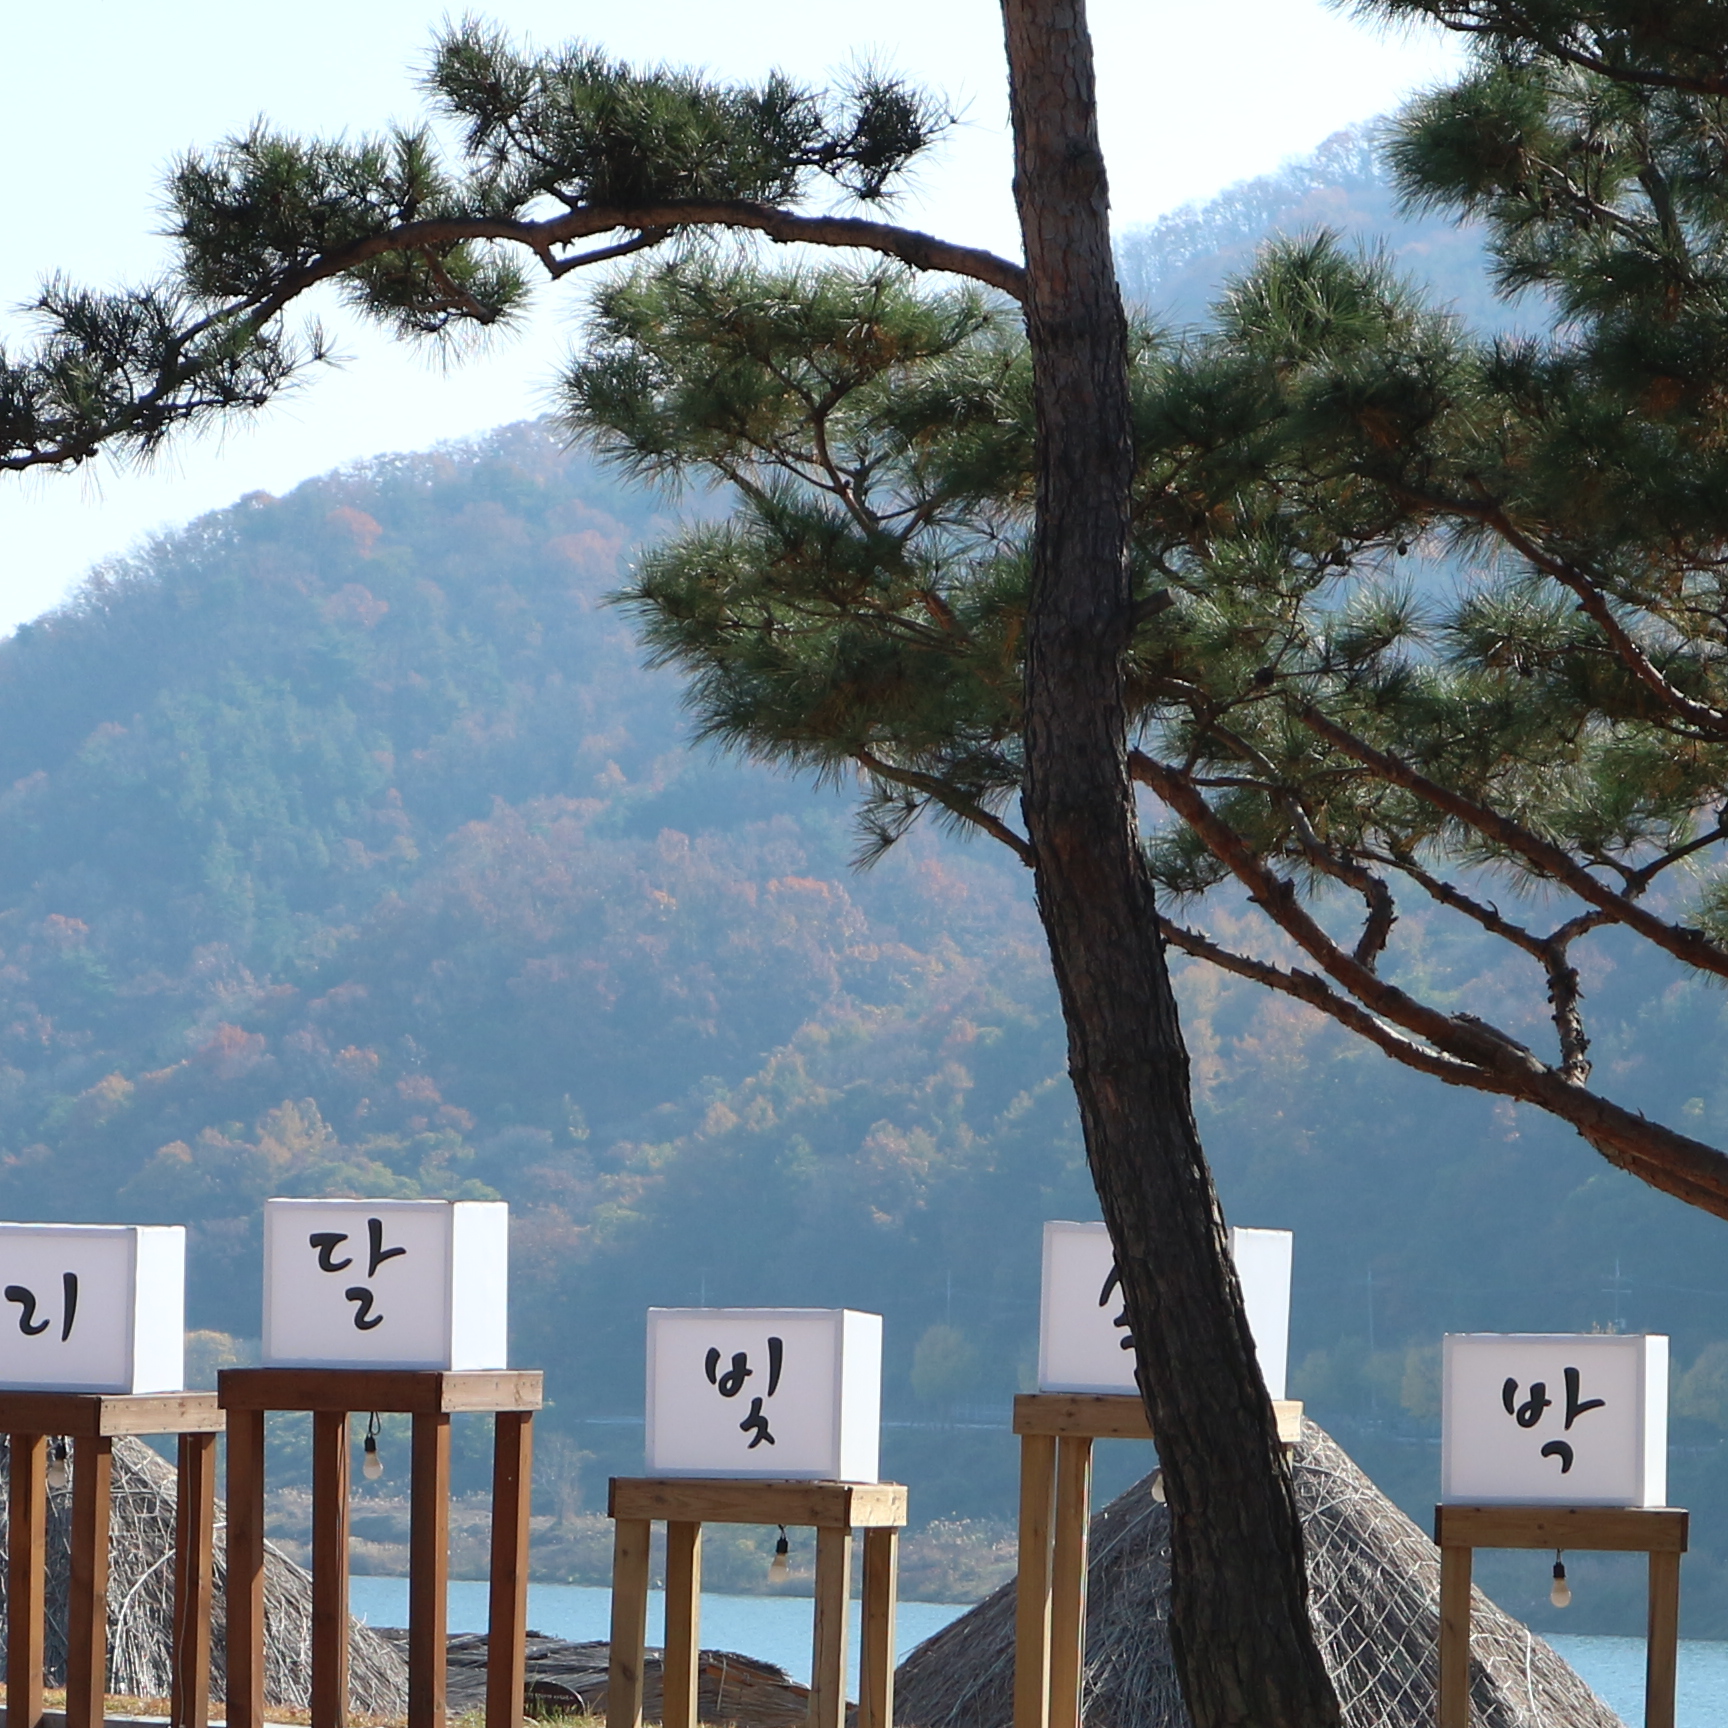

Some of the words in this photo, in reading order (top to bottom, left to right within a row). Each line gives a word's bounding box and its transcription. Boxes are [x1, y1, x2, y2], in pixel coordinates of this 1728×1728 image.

[4, 1272, 78, 1343] 리
[309, 1218, 407, 1331] 달
[704, 1336, 784, 1450] 빛
[1501, 1366, 1606, 1475] 박
